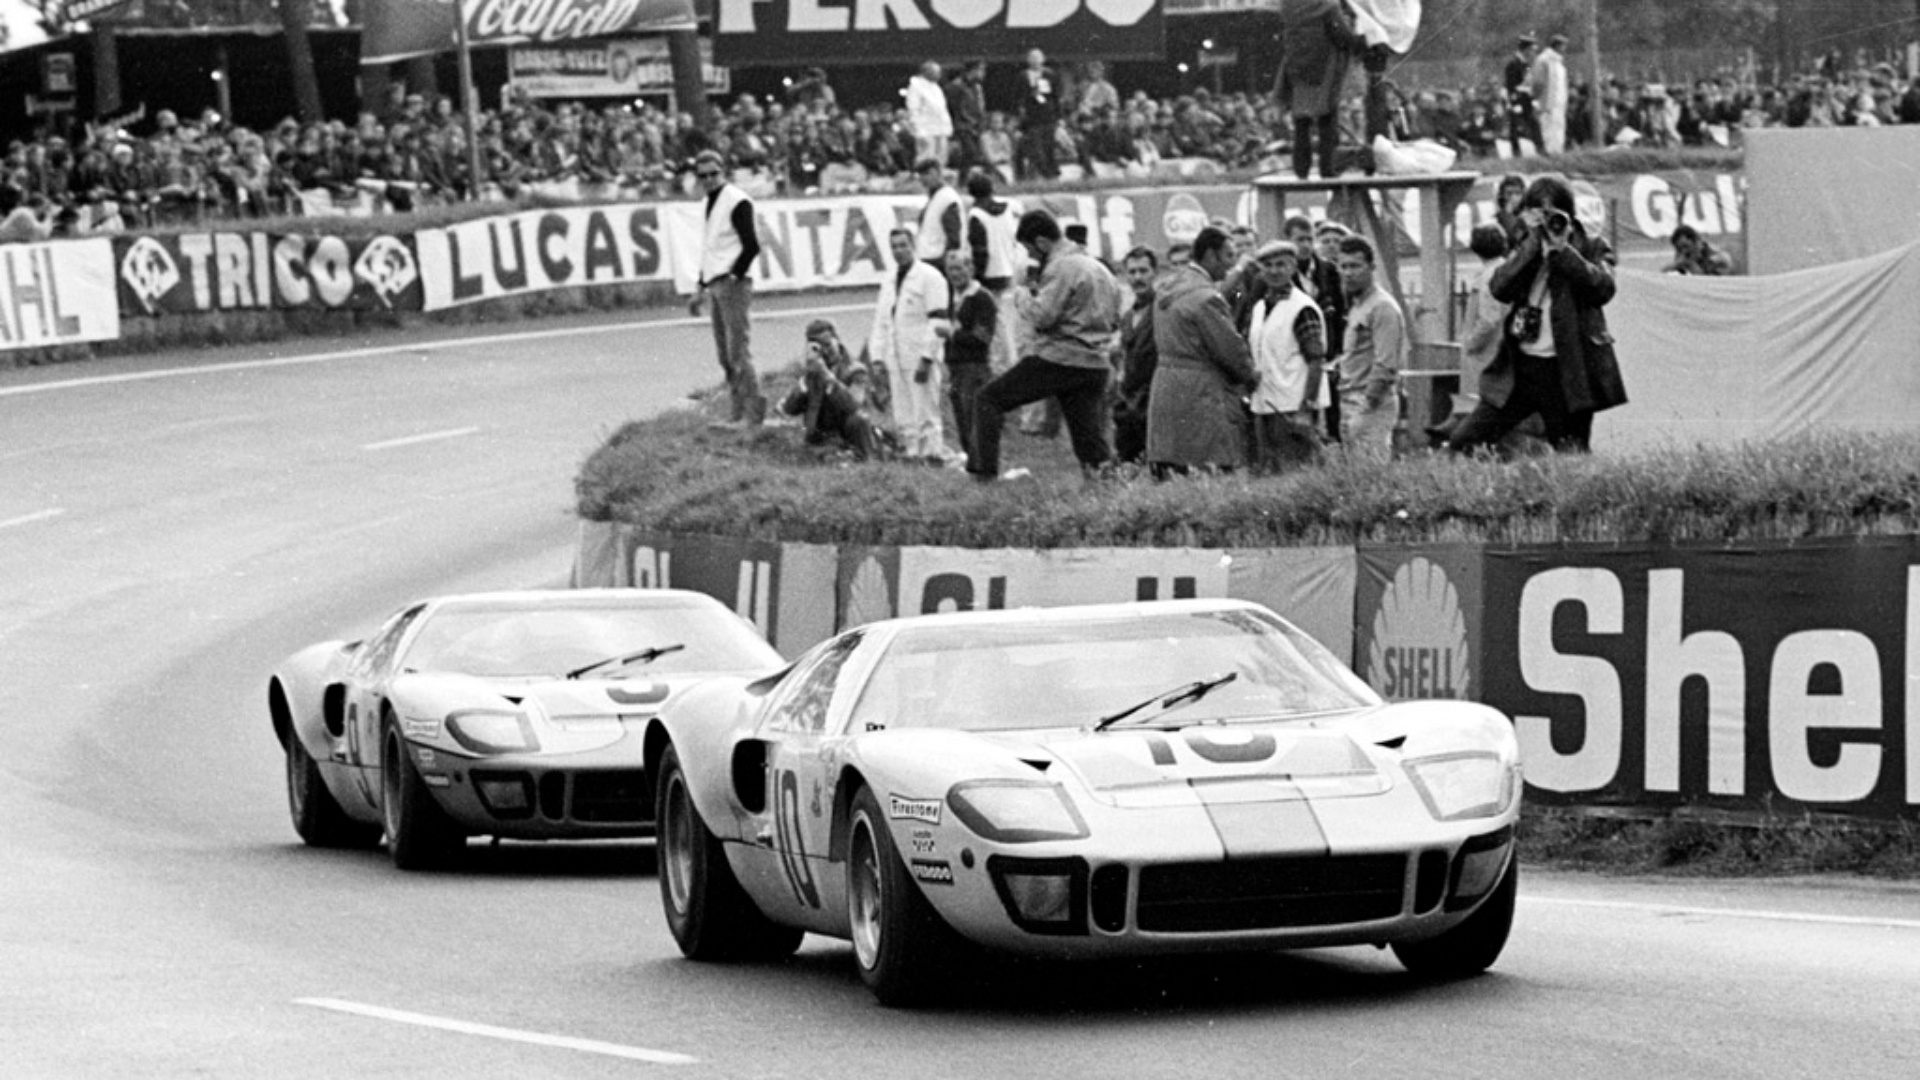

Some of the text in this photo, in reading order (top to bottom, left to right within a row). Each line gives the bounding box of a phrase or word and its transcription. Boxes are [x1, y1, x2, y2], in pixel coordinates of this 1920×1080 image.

[1631, 174, 1749, 238] Gul
[179, 232, 354, 309] TRICO
[446, 207, 661, 301] LUCAS
[1384, 646, 1457, 699] SHELL
[774, 768, 821, 910] 10
